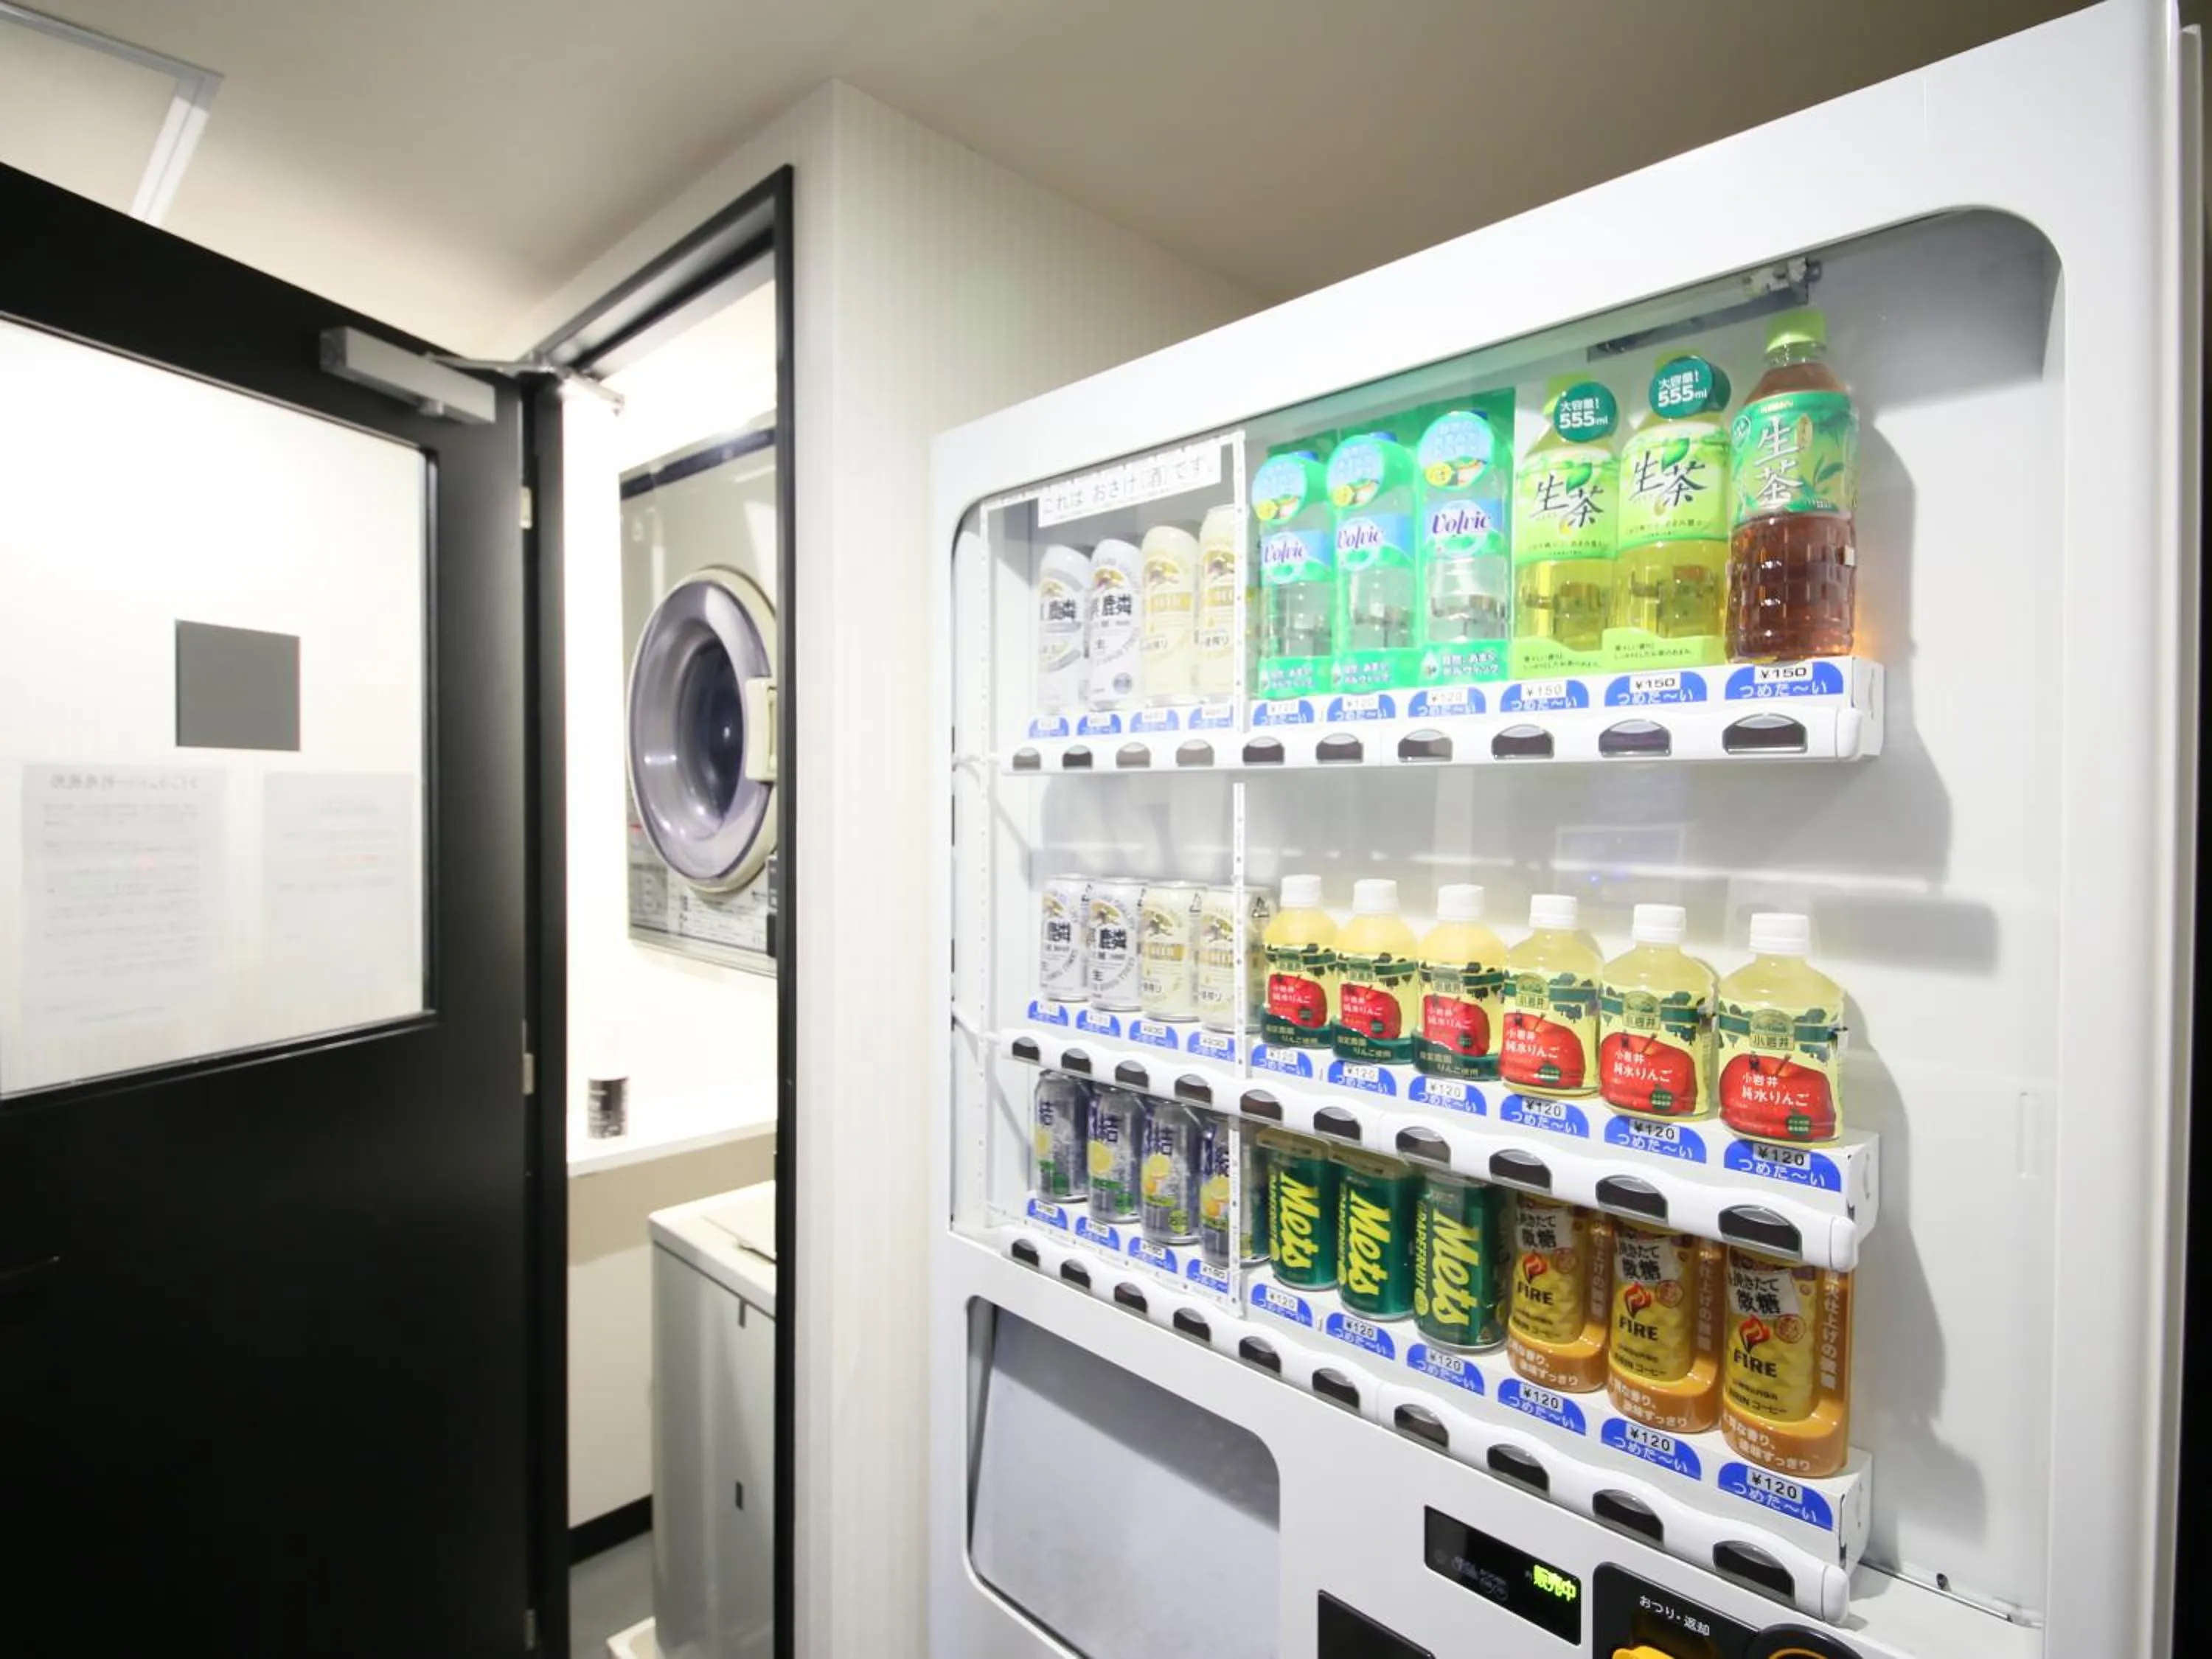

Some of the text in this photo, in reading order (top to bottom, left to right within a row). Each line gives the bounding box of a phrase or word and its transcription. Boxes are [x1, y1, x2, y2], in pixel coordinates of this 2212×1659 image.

[1658, 385, 1707, 408] 555ml
[1559, 411, 1608, 429] 555ml
[1629, 451, 1708, 507] 生茶
[1530, 473, 1604, 528] 生茶
[1432, 509, 1490, 535] Volvic
[1337, 525, 1383, 550] Volvic
[1264, 541, 1304, 564] Volvic
[1635, 678, 1676, 690] ¥150
[1760, 667, 1807, 679] ¥150
[1431, 691, 1463, 703] ¥120
[1526, 684, 1563, 697] ¥150
[1346, 1064, 1376, 1079] ¥120
[1742, 1071, 1779, 1088] 小岩井
[1429, 1083, 1462, 1099] ¥120
[1741, 1085, 1810, 1107] 純水りんご
[1525, 1099, 1562, 1117] ¥120
[1633, 1120, 1675, 1140] ¥120
[1757, 1144, 1805, 1166] ¥120
[1279, 1170, 1321, 1268] Mets
[1348, 1189, 1391, 1295] Mets
[1432, 1208, 1480, 1326] Mets
[1268, 1292, 1295, 1309] ¥120
[1517, 1280, 1554, 1306] FIRE
[1736, 1288, 1781, 1315] 微糖
[1346, 1319, 1375, 1338] ¥120
[1618, 1314, 1658, 1342] FIRE
[1429, 1351, 1462, 1371] ¥120
[1733, 1348, 1778, 1379] FIRE
[1523, 1388, 1559, 1410] ¥120
[1629, 1427, 1671, 1453] ¥120
[1751, 1472, 1798, 1500] ¥120
[1532, 1563, 1577, 1602] 販売中
[1639, 1594, 1711, 1638] おつり・返却
